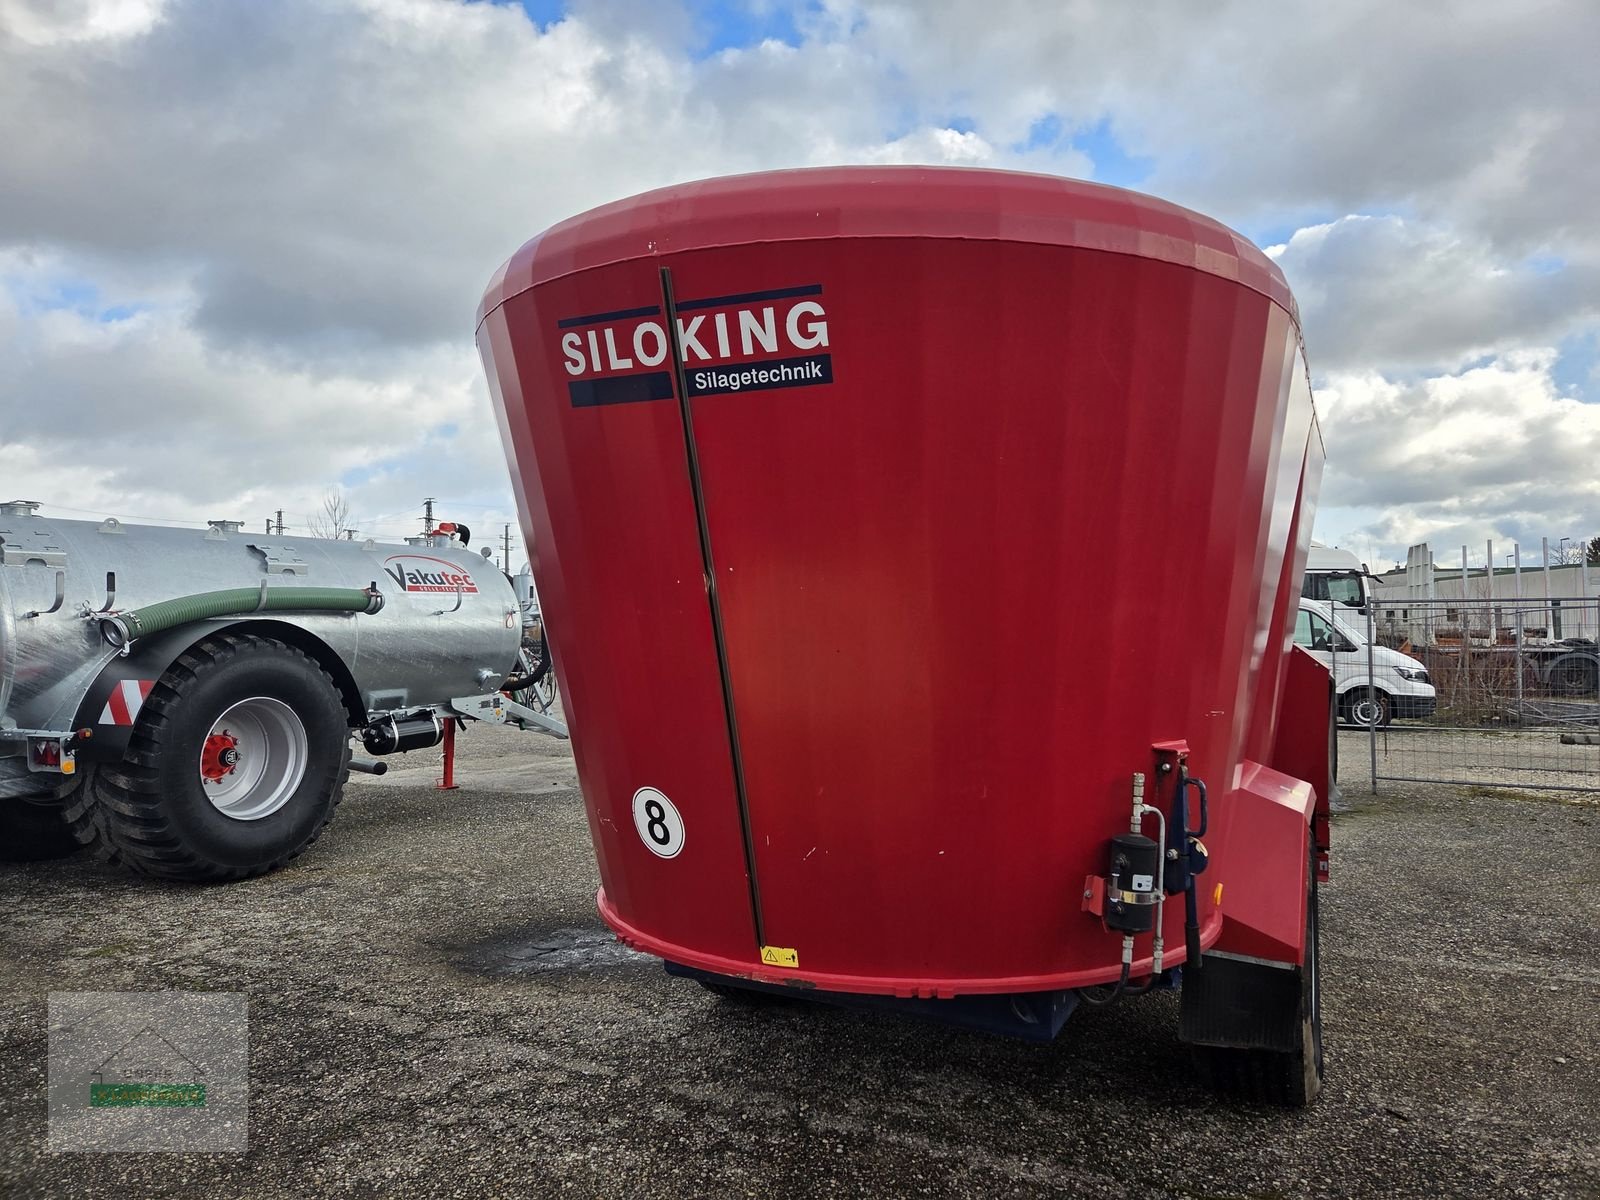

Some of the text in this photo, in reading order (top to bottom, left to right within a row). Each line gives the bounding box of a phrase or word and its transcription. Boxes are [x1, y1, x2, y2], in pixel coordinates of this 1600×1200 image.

[562, 301, 830, 376] SILOKING
[695, 361, 823, 391] Silagetechnik
[384, 563, 475, 591] Vakutec
[645, 799, 670, 846] 8
